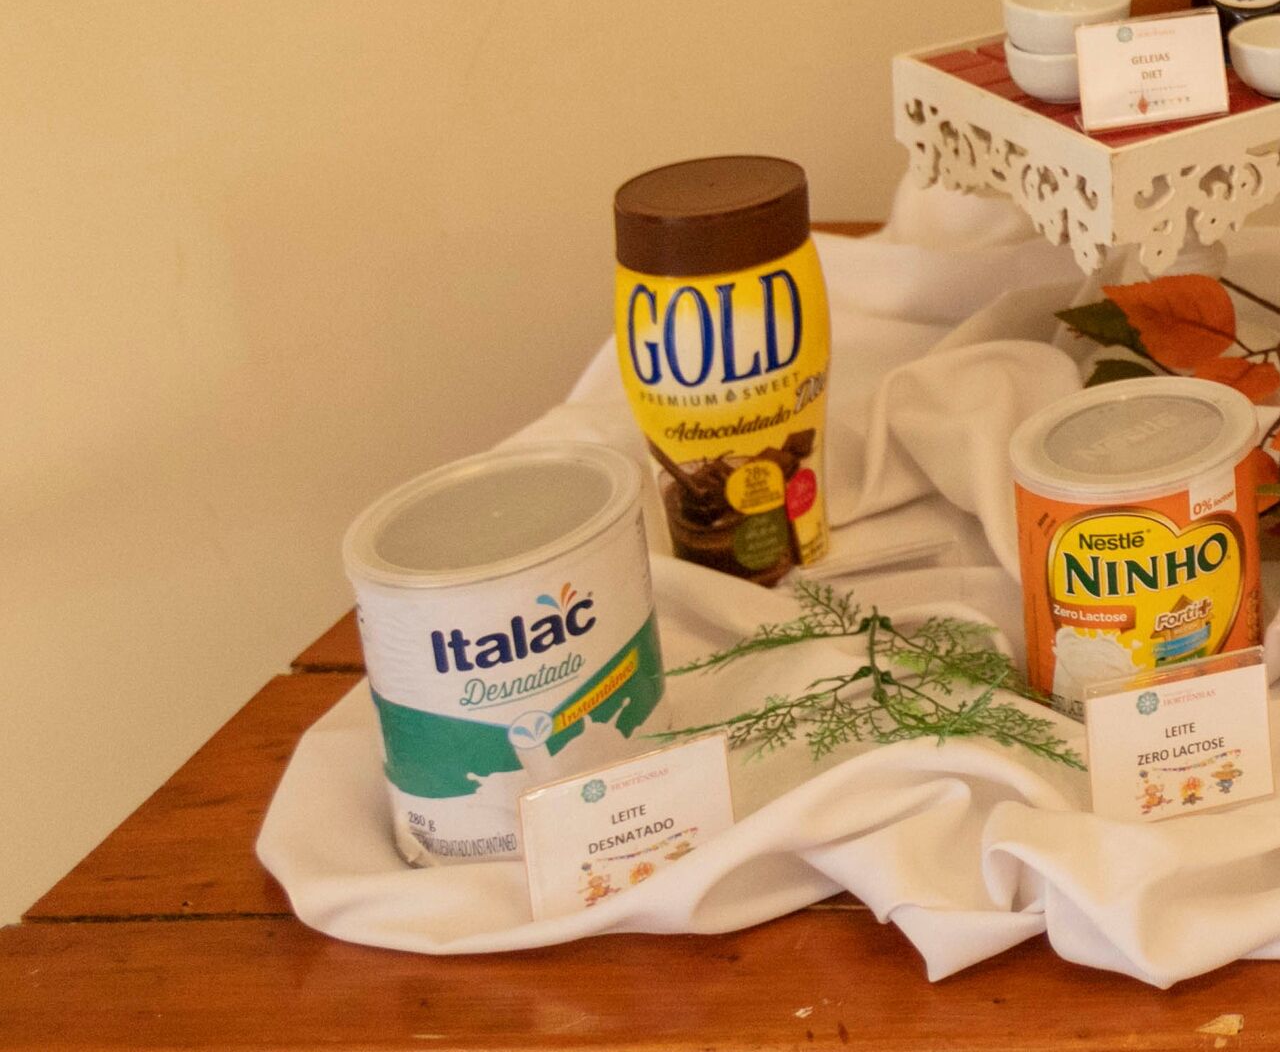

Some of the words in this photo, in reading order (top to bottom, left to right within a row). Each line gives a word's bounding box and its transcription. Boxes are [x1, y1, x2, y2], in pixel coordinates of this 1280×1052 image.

[1131, 52, 1170, 66] GELEIAS
[1141, 69, 1163, 81] DIET
[627, 269, 803, 388] GOLD
[639, 391, 719, 407] PREMIUM
[743, 373, 800, 401] SWEET
[664, 404, 791, 443] Achocolatado
[1193, 497, 1213, 516] 0%
[1062, 532, 1228, 598] NINHO
[1053, 603, 1078, 619] Zero
[1079, 608, 1128, 623] Lactose
[1155, 597, 1213, 631] Forti+
[431, 598, 597, 674] Italac
[459, 652, 586, 707] Desnatado
[1165, 722, 1196, 739] LEITE
[1137, 748, 1170, 766] ZERO
[1172, 737, 1225, 759] LACTOSE
[407, 811, 426, 826] 280
[610, 804, 647, 825] LEITE
[588, 817, 675, 855] DESNATADO
